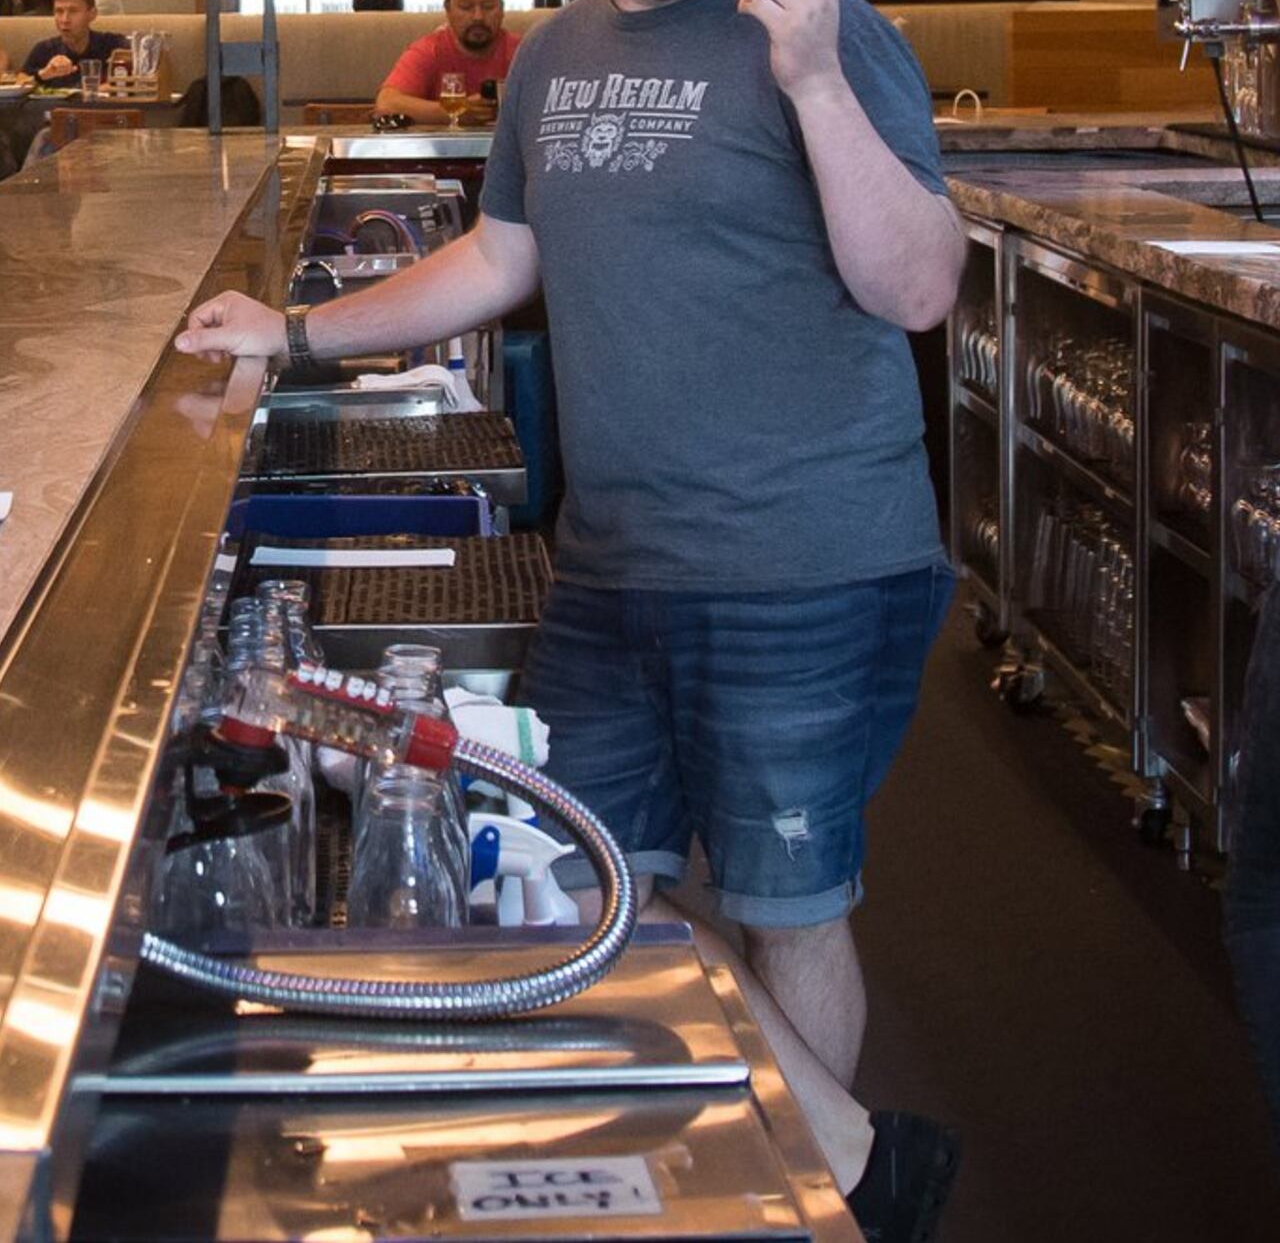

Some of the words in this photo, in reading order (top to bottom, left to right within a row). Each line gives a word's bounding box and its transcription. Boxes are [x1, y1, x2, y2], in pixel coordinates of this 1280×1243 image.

[543, 76, 601, 114] NEW
[598, 73, 710, 112] REALM
[539, 119, 584, 136] BREWING
[629, 117, 694, 132] COMPANY
[489, 1170, 623, 1190] ICE
